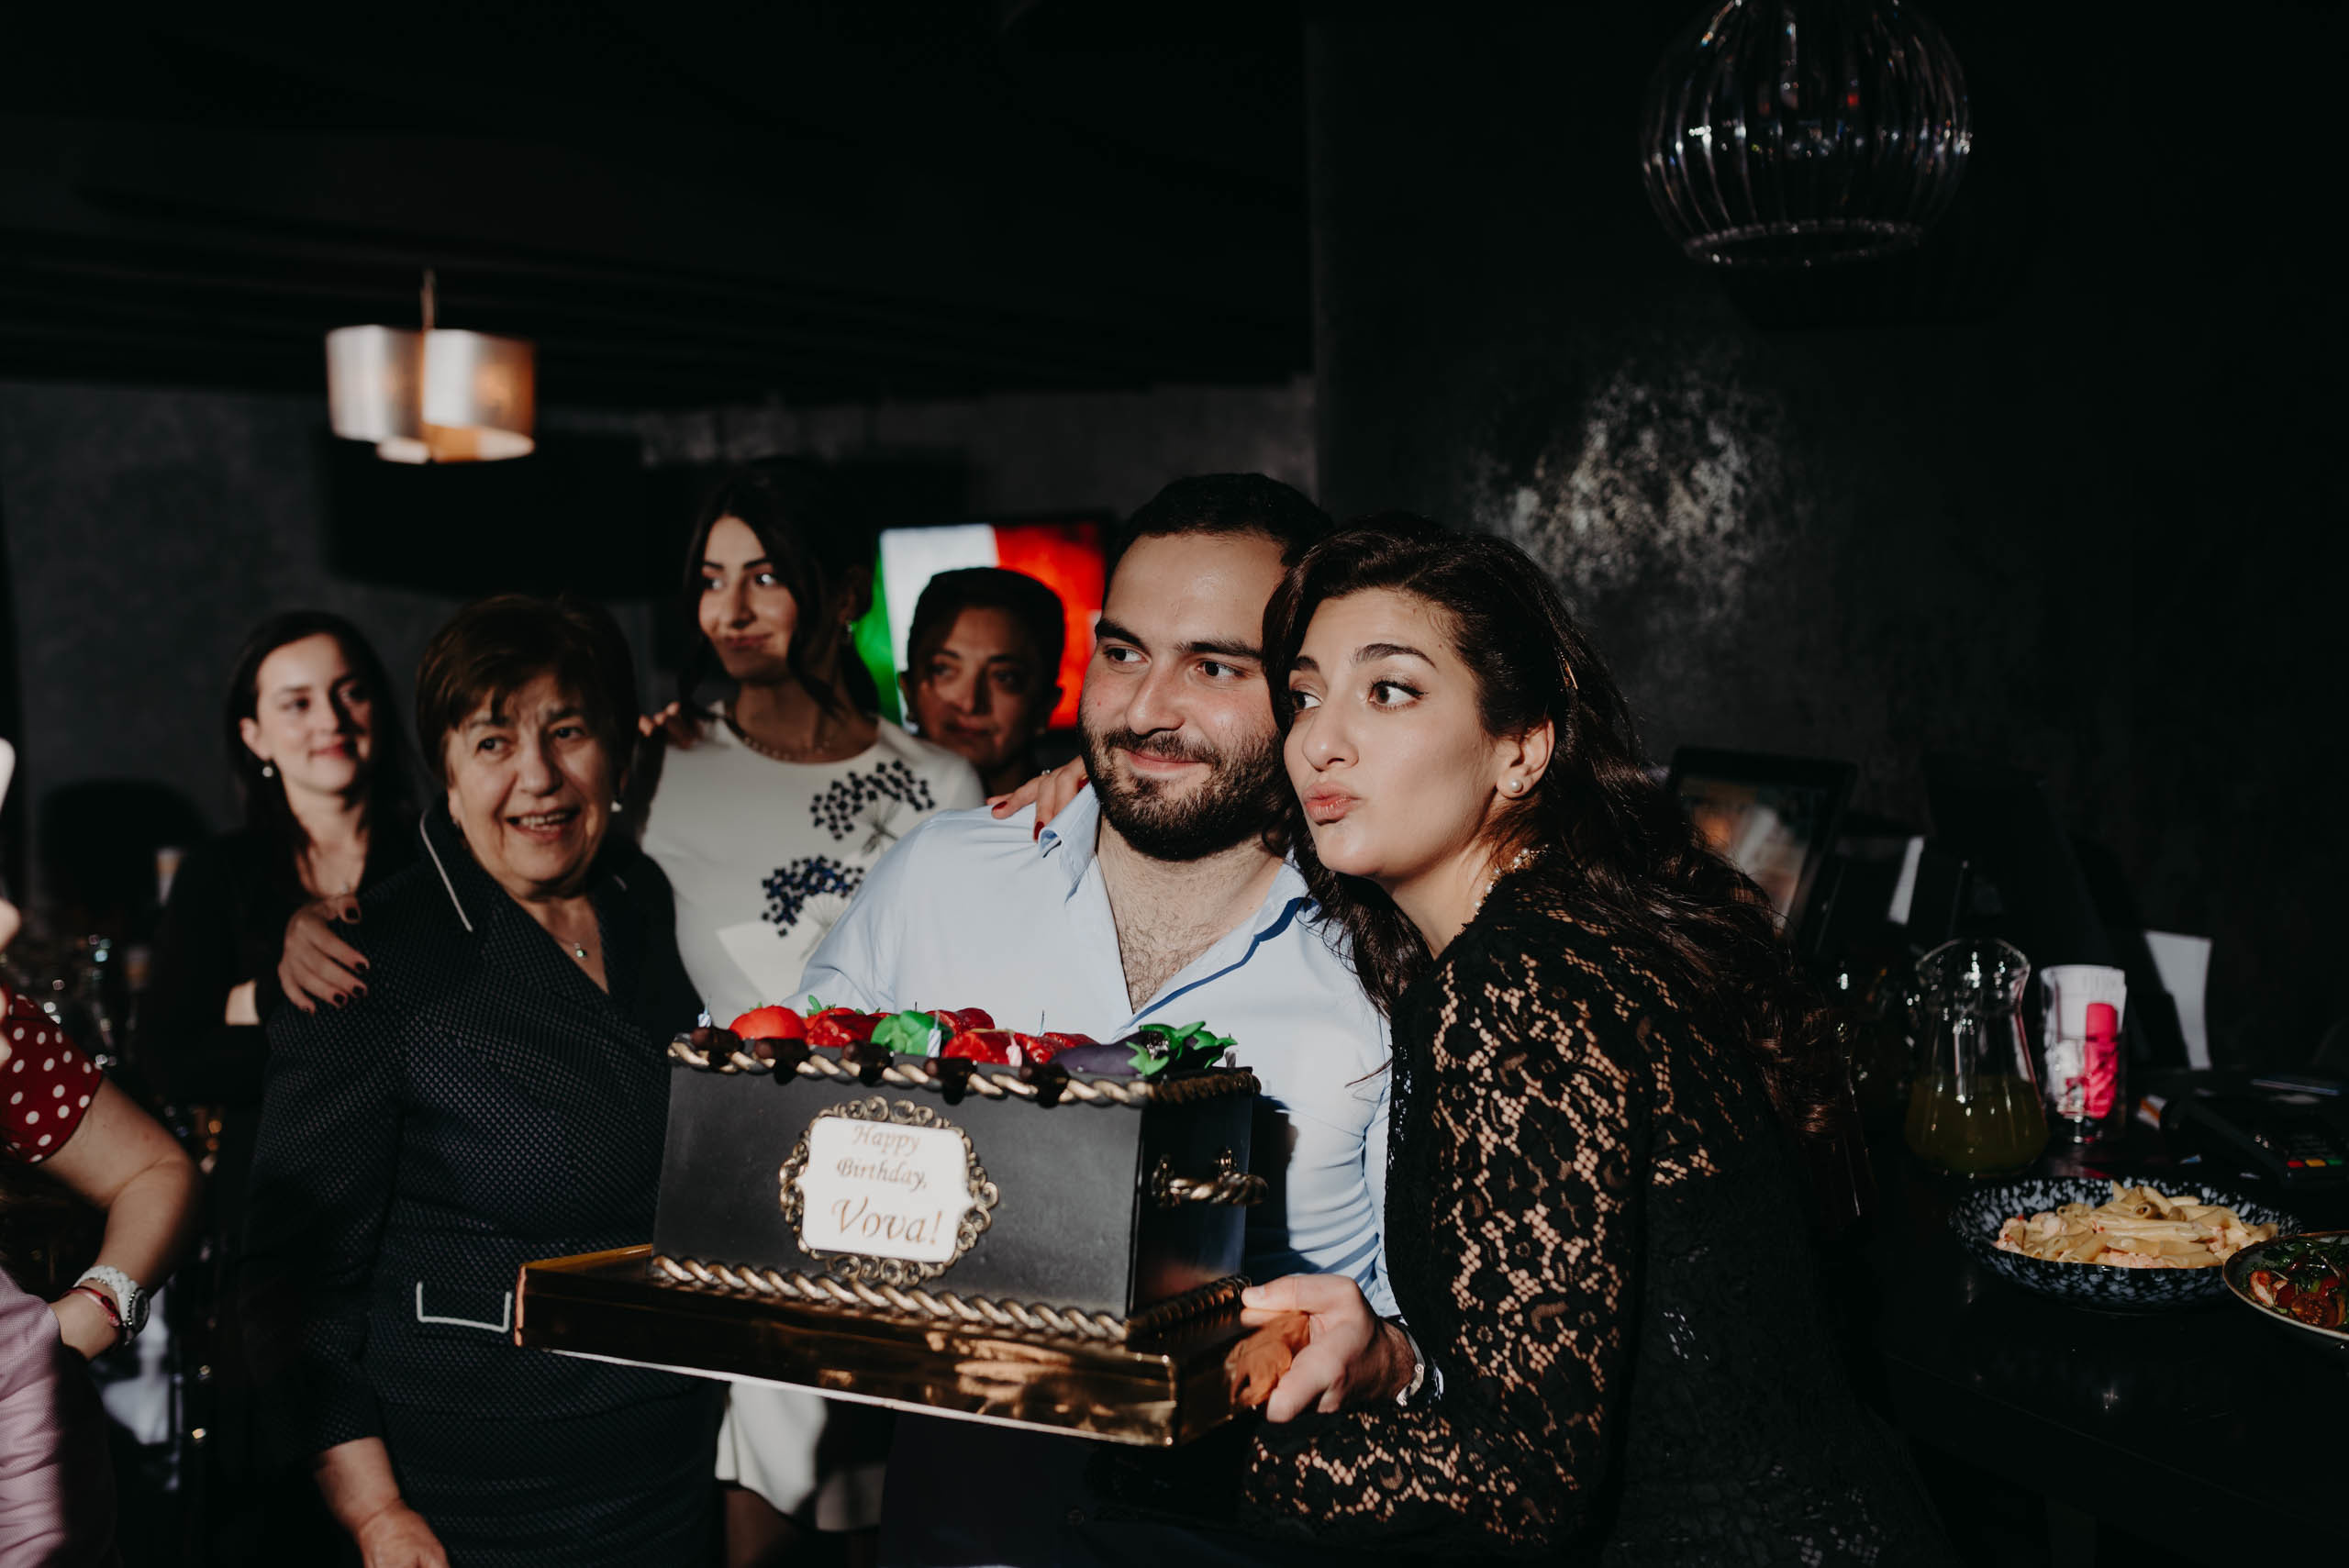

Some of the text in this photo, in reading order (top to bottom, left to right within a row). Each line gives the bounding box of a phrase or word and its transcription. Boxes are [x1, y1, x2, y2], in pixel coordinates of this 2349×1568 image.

[852, 1125, 920, 1156] Happy
[836, 1157, 927, 1192] Birthday,
[830, 1196, 943, 1245] Vova!
